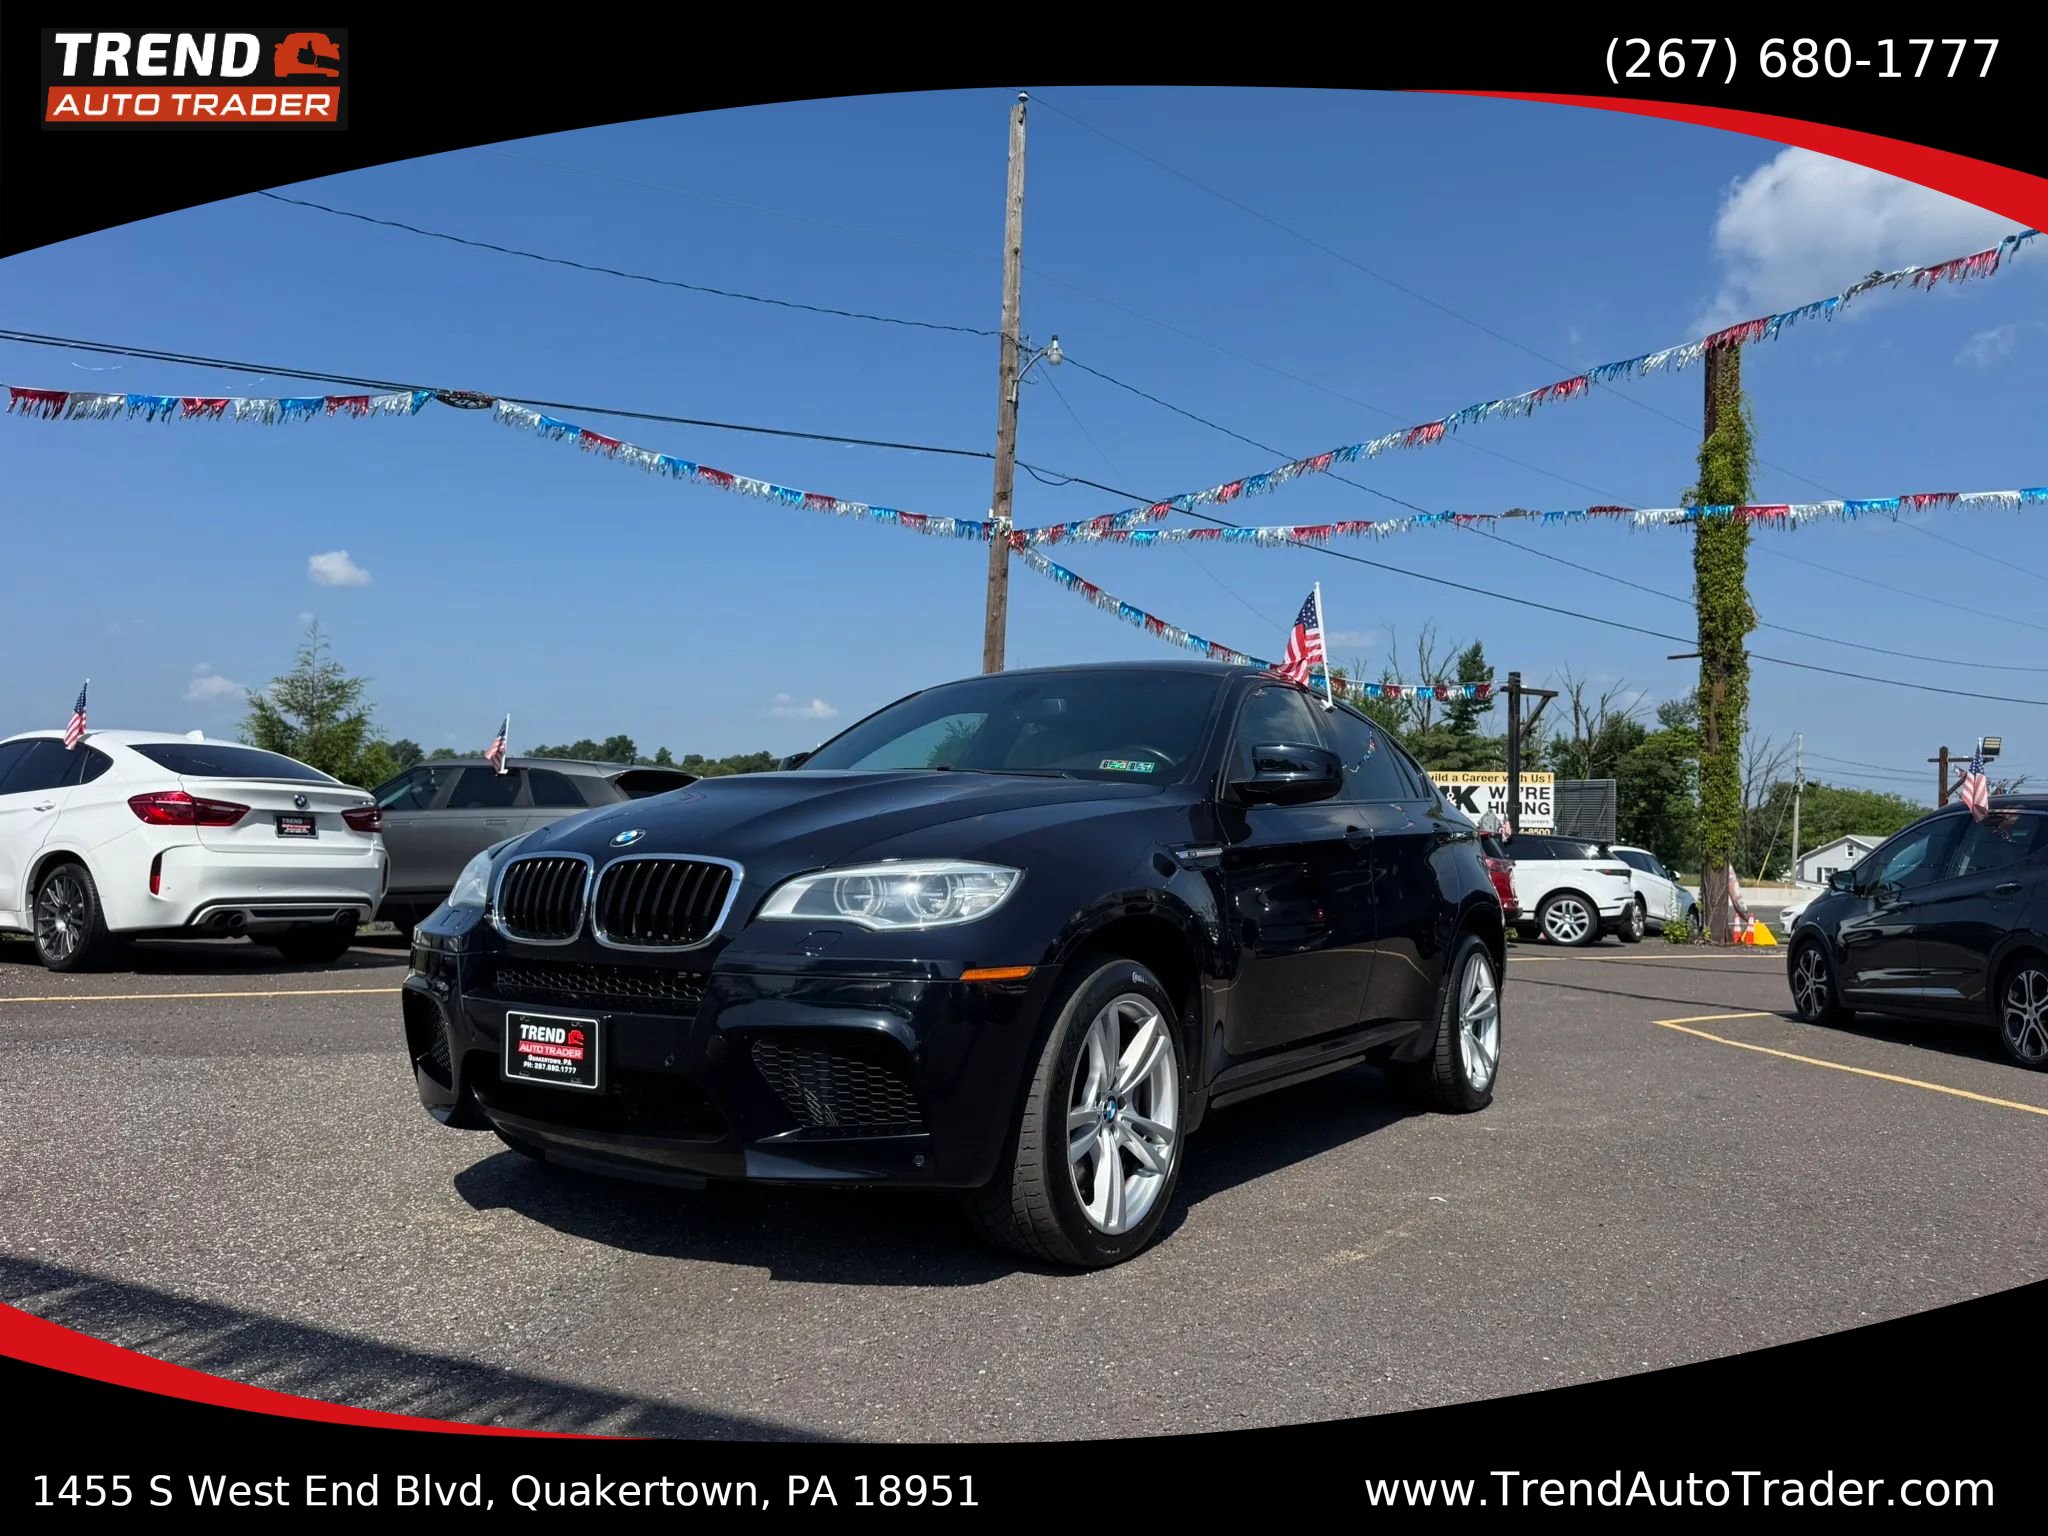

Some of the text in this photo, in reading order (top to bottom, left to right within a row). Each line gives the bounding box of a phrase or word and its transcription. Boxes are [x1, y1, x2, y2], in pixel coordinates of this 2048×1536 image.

[1462, 773, 1499, 782] Career
[1488, 786, 1550, 800] W'RE
[1488, 801, 1550, 815] HIING
[520, 1024, 566, 1044] TREND
[519, 1042, 583, 1059] AUTO TRADER
